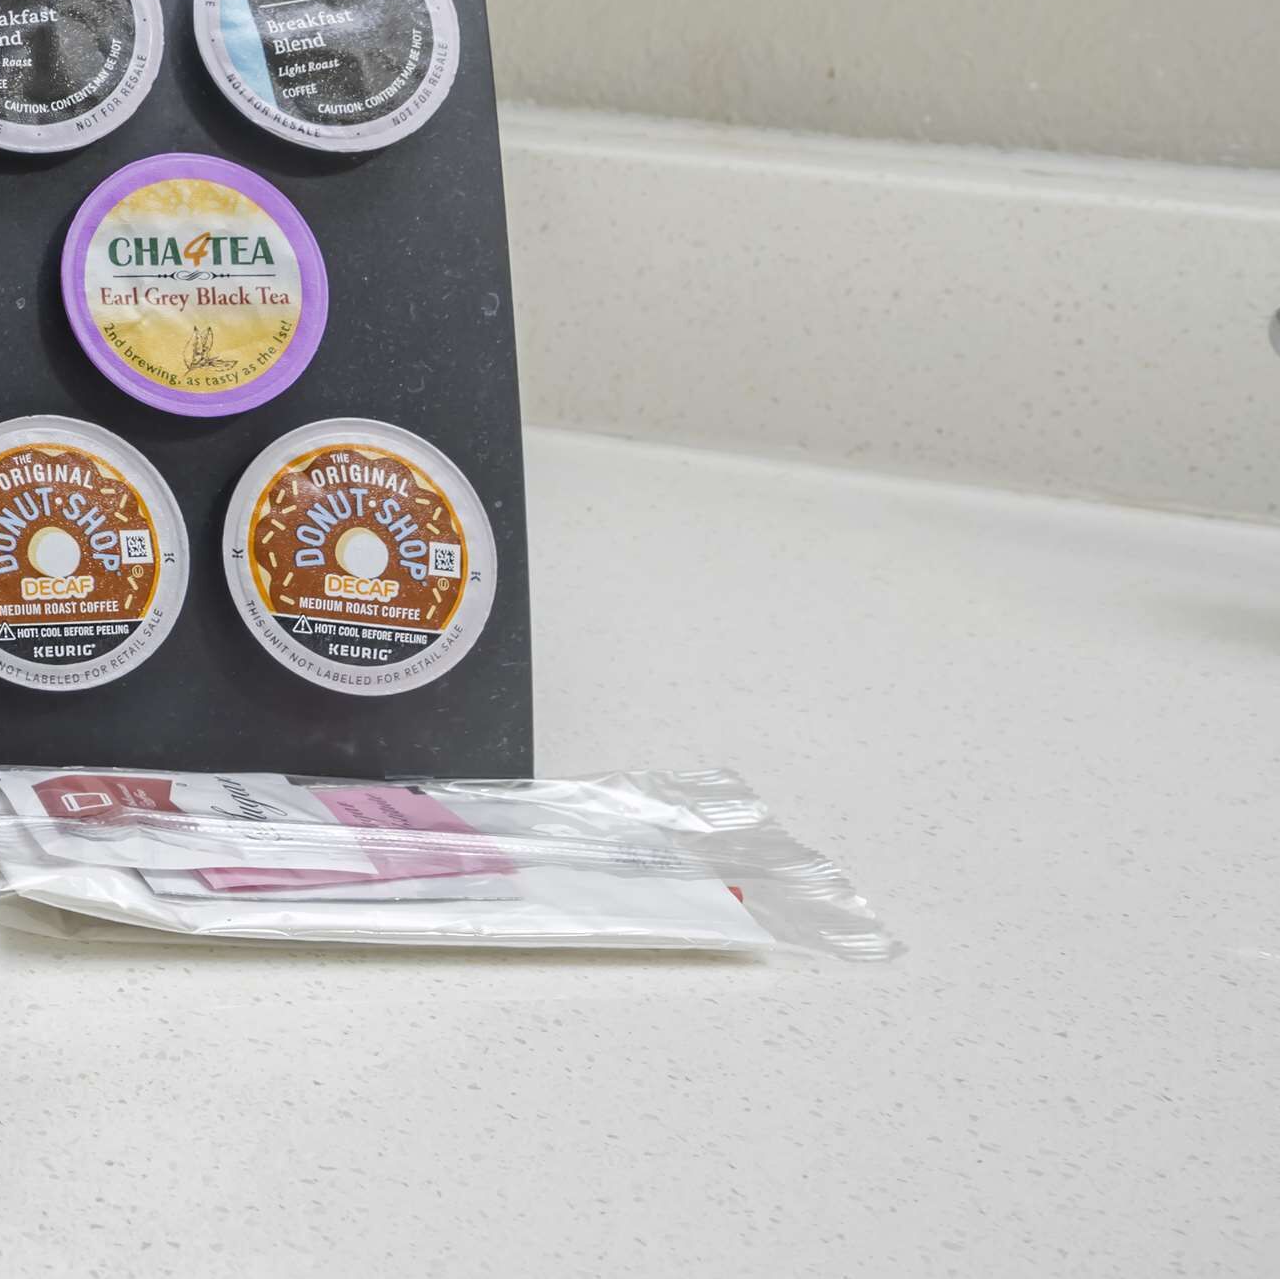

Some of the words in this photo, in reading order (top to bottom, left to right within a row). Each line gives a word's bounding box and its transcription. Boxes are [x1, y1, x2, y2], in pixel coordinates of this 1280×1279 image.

[266, 10, 353, 35] Breakfast
[109, 38, 123, 59] HOT
[273, 34, 326, 55] Blend
[411, 28, 422, 48] HOT
[2, 57, 32, 68] Roast
[104, 56, 117, 71] BE
[408, 48, 421, 63] BE
[93, 69, 110, 88] MAY
[278, 64, 307, 78] Light
[308, 58, 340, 71] Roast
[400, 63, 417, 81] MAY
[75, 114, 99, 132] NOT
[101, 97, 123, 117] FOR
[120, 54, 147, 97] RESALE
[282, 83, 318, 99] COFFEE
[365, 77, 405, 109] CONTENTS
[392, 107, 414, 126] NOT
[415, 88, 432, 110] FOR
[428, 42, 449, 87] RESALE
[4, 100, 50, 114] CAUTION:
[51, 83, 96, 111] CONTENTS
[225, 72, 247, 97] NOT
[273, 114, 322, 138] RESALE
[318, 102, 365, 115] CAUTION:
[100, 286, 138, 306] Earl
[145, 287, 189, 311] Grey
[196, 285, 251, 306] Black
[255, 286, 290, 306] Tea
[104, 323, 125, 348] 2nd
[125, 346, 182, 385] brewing,
[186, 376, 201, 386] as
[205, 371, 239, 388] tasty
[242, 364, 257, 376] as
[257, 346, 277, 364] the
[13, 453, 33, 465] THE
[330, 453, 349, 463] THE
[311, 464, 409, 497] ORIGINAL
[63, 492, 122, 574] SHOP
[294, 487, 369, 570] DONUT
[374, 497, 429, 583] SHOP
[25, 578, 92, 597] DECAF
[327, 577, 397, 598] DECAF
[0, 604, 41, 616] MEDIUM
[45, 602, 77, 614] ROAST
[80, 601, 119, 613] COFFEE
[299, 597, 342, 611] MEDIUM
[346, 603, 379, 615] ROAST
[381, 607, 421, 620] COFFEE
[17, 628, 39, 638] HOT!
[41, 627, 62, 638] COOL
[64, 626, 94, 636] BEFORE
[96, 624, 129, 635] PEELING
[315, 624, 336, 635] HOT!
[338, 626, 360, 638] COOL
[362, 630, 392, 641] BEFORE
[394, 633, 428, 645] PEELING
[25, 671, 80, 685] LABELED
[85, 665, 107, 679] FOR
[110, 640, 145, 670] RETAIL
[143, 608, 163, 638] SALE
[33, 644, 93, 658] KEURIG
[247, 600, 266, 628] THIS
[264, 629, 289, 653] UNIT
[289, 652, 314, 671] NOT
[316, 667, 372, 686] LABELED
[377, 673, 400, 685] FOR
[405, 651, 441, 677] RETAIL
[442, 624, 464, 652] SALE
[328, 643, 389, 661] KEURIG
